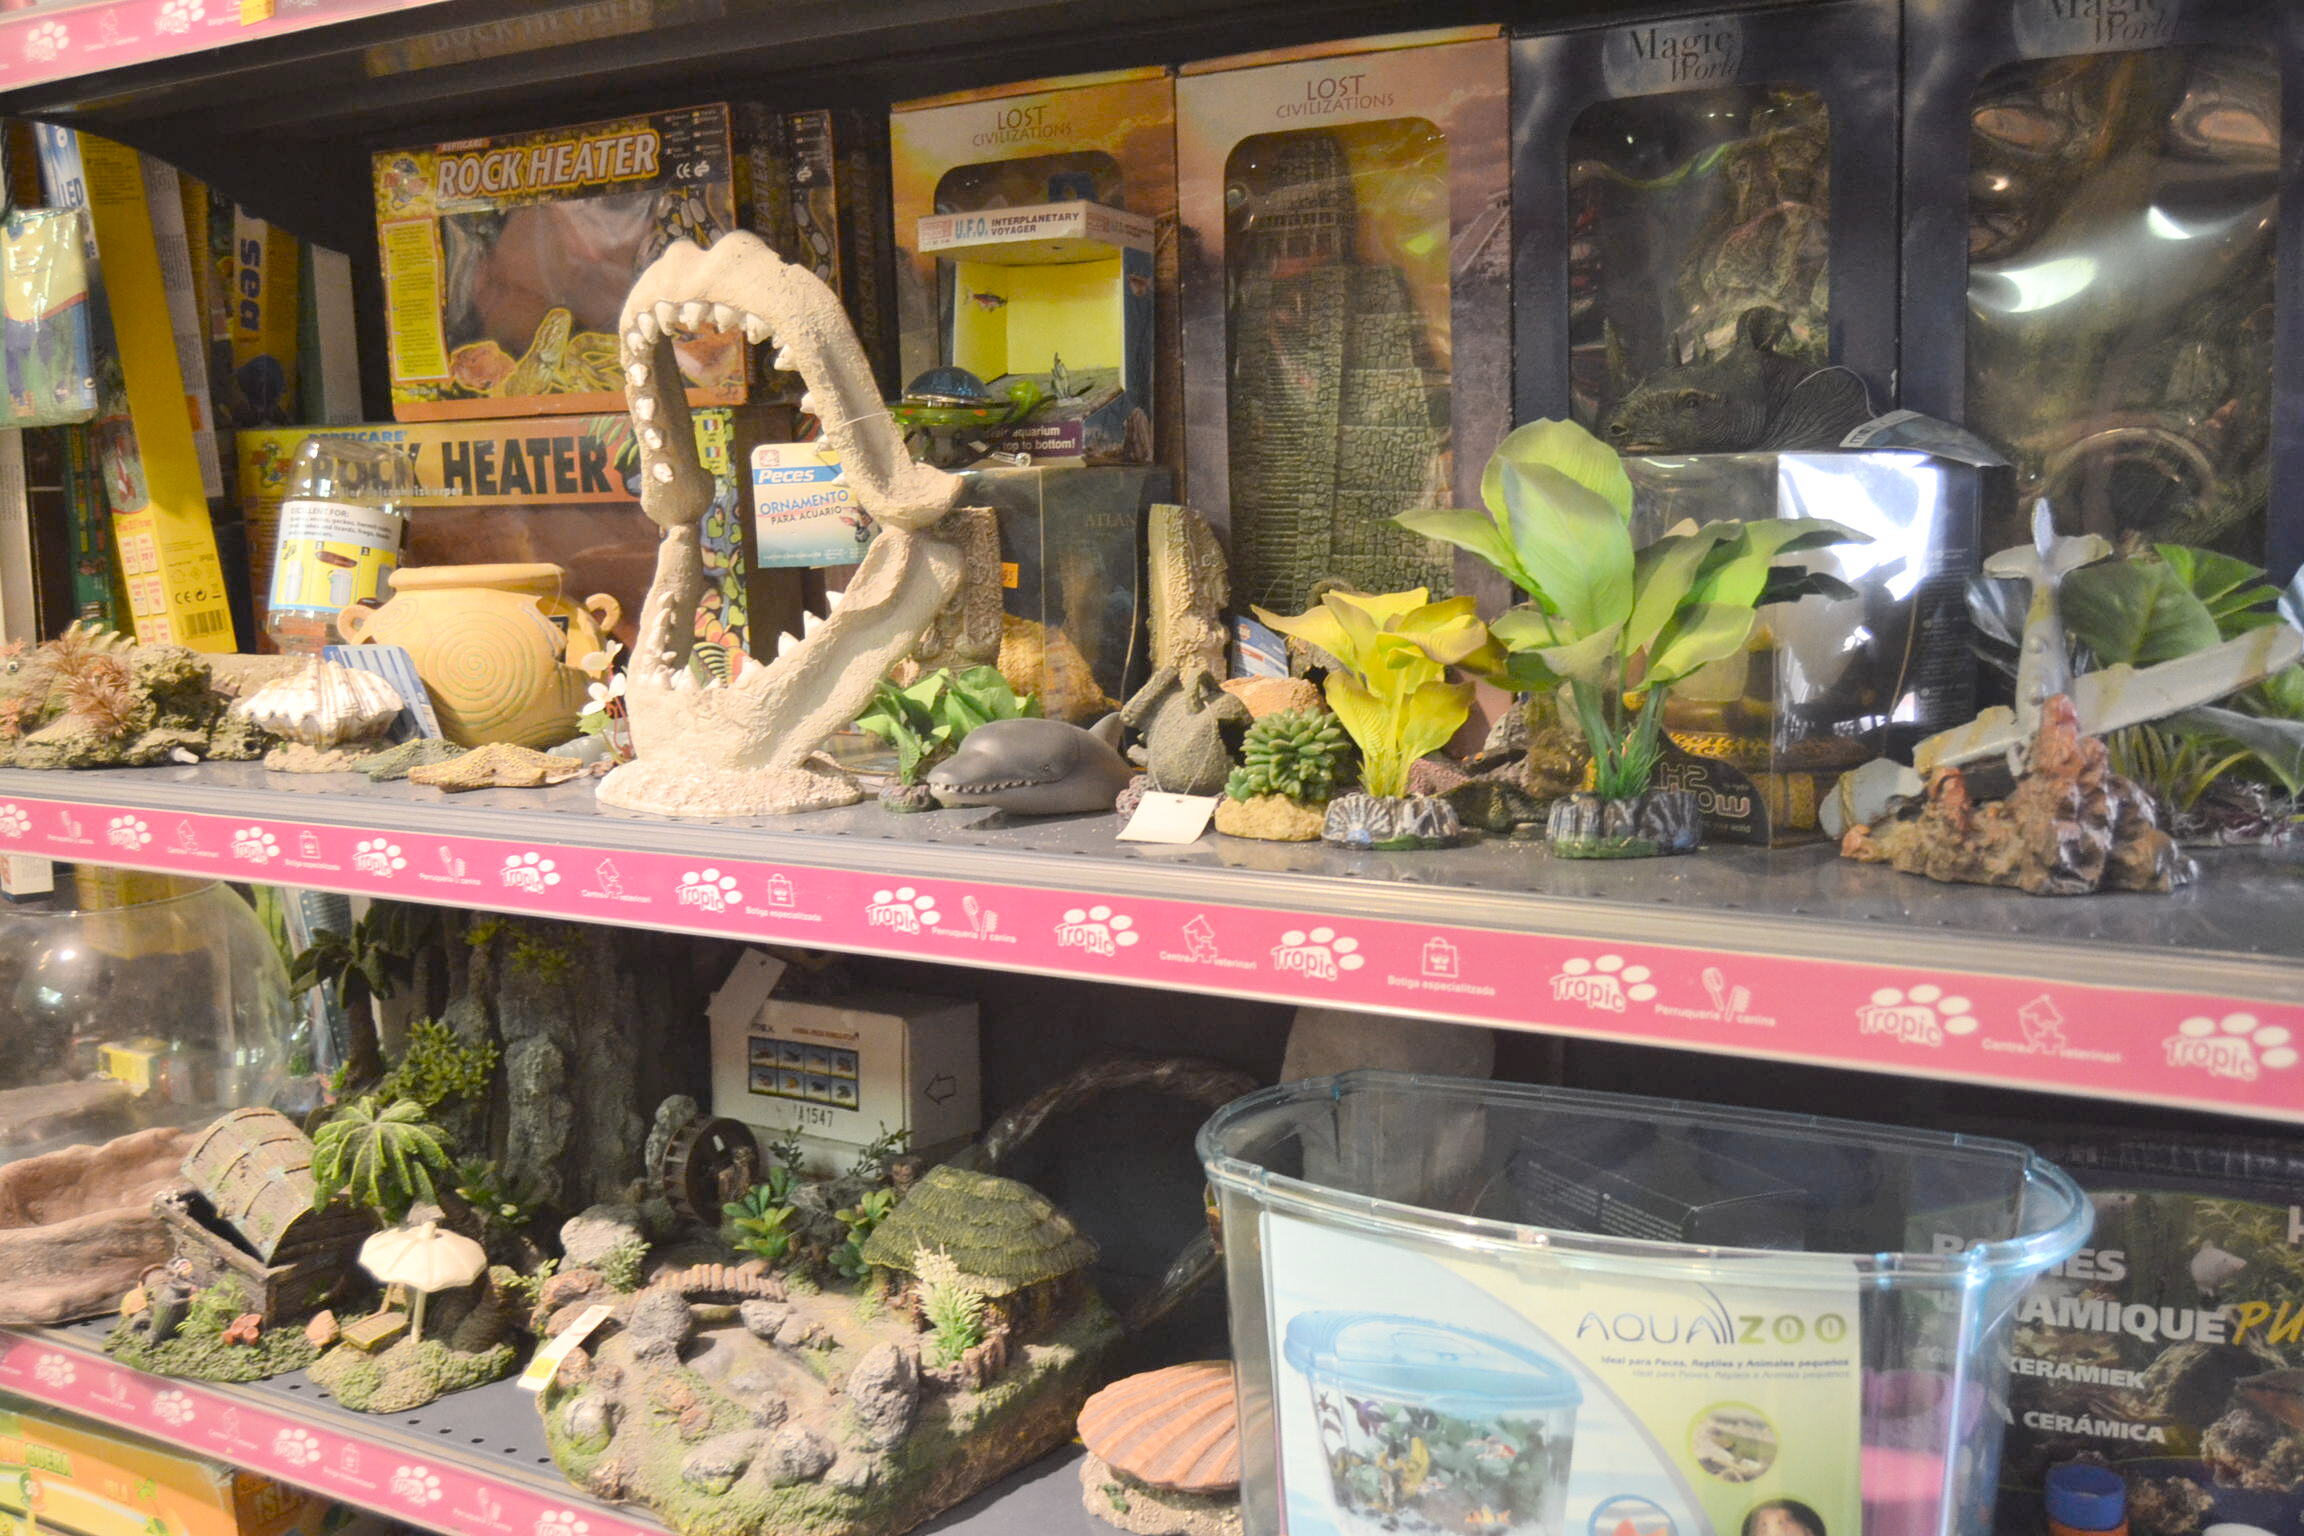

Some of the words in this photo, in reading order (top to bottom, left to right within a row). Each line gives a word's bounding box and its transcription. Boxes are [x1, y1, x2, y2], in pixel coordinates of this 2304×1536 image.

[1630, 21, 1732, 60] Magic
[1671, 50, 1746, 82] World
[1307, 74, 1366, 101] LOST
[997, 104, 1048, 130] LOST
[1276, 93, 1395, 119] CIVILIZATIONS
[972, 121, 1072, 147] CIVILIZATIONS
[437, 151, 522, 199] ROCK
[528, 133, 657, 187] HEATER
[955, 217, 988, 240] U.F.O.
[991, 211, 1080, 228] INTERPLANETARY
[991, 225, 1037, 236] VOYAGER
[1012, 425, 1061, 439] aquarium
[1022, 440, 1033, 450] to
[1035, 437, 1076, 450] bottom!
[442, 437, 613, 496] HEATER
[759, 469, 816, 484] Peces
[760, 490, 849, 515] ORNAMENTO
[771, 515, 797, 526] PARA
[799, 505, 842, 520] ACUARIO
[500, 866, 545, 894] Tropic
[675, 884, 726, 913] Tropic
[865, 903, 921, 935] Tropic
[1054, 922, 1117, 957] Tropic
[1270, 946, 1339, 981] Tropic
[1387, 974, 1421, 990] Botiga
[1421, 980, 1496, 997] especialitzada
[1549, 974, 1627, 1013] Tropic
[1654, 1003, 1722, 1022] Perruqueria
[1736, 1014, 1777, 1028] canina
[1856, 1006, 1943, 1047] Tropic
[2162, 1037, 2260, 1081] Tropic
[1601, 1355, 1626, 1366] Ideal
[1628, 1358, 1652, 1368] para
[1691, 1358, 1734, 1369] Reptiles
[1746, 1358, 1795, 1368] Animales
[2023, 1409, 2166, 1445] CERÁMICA
